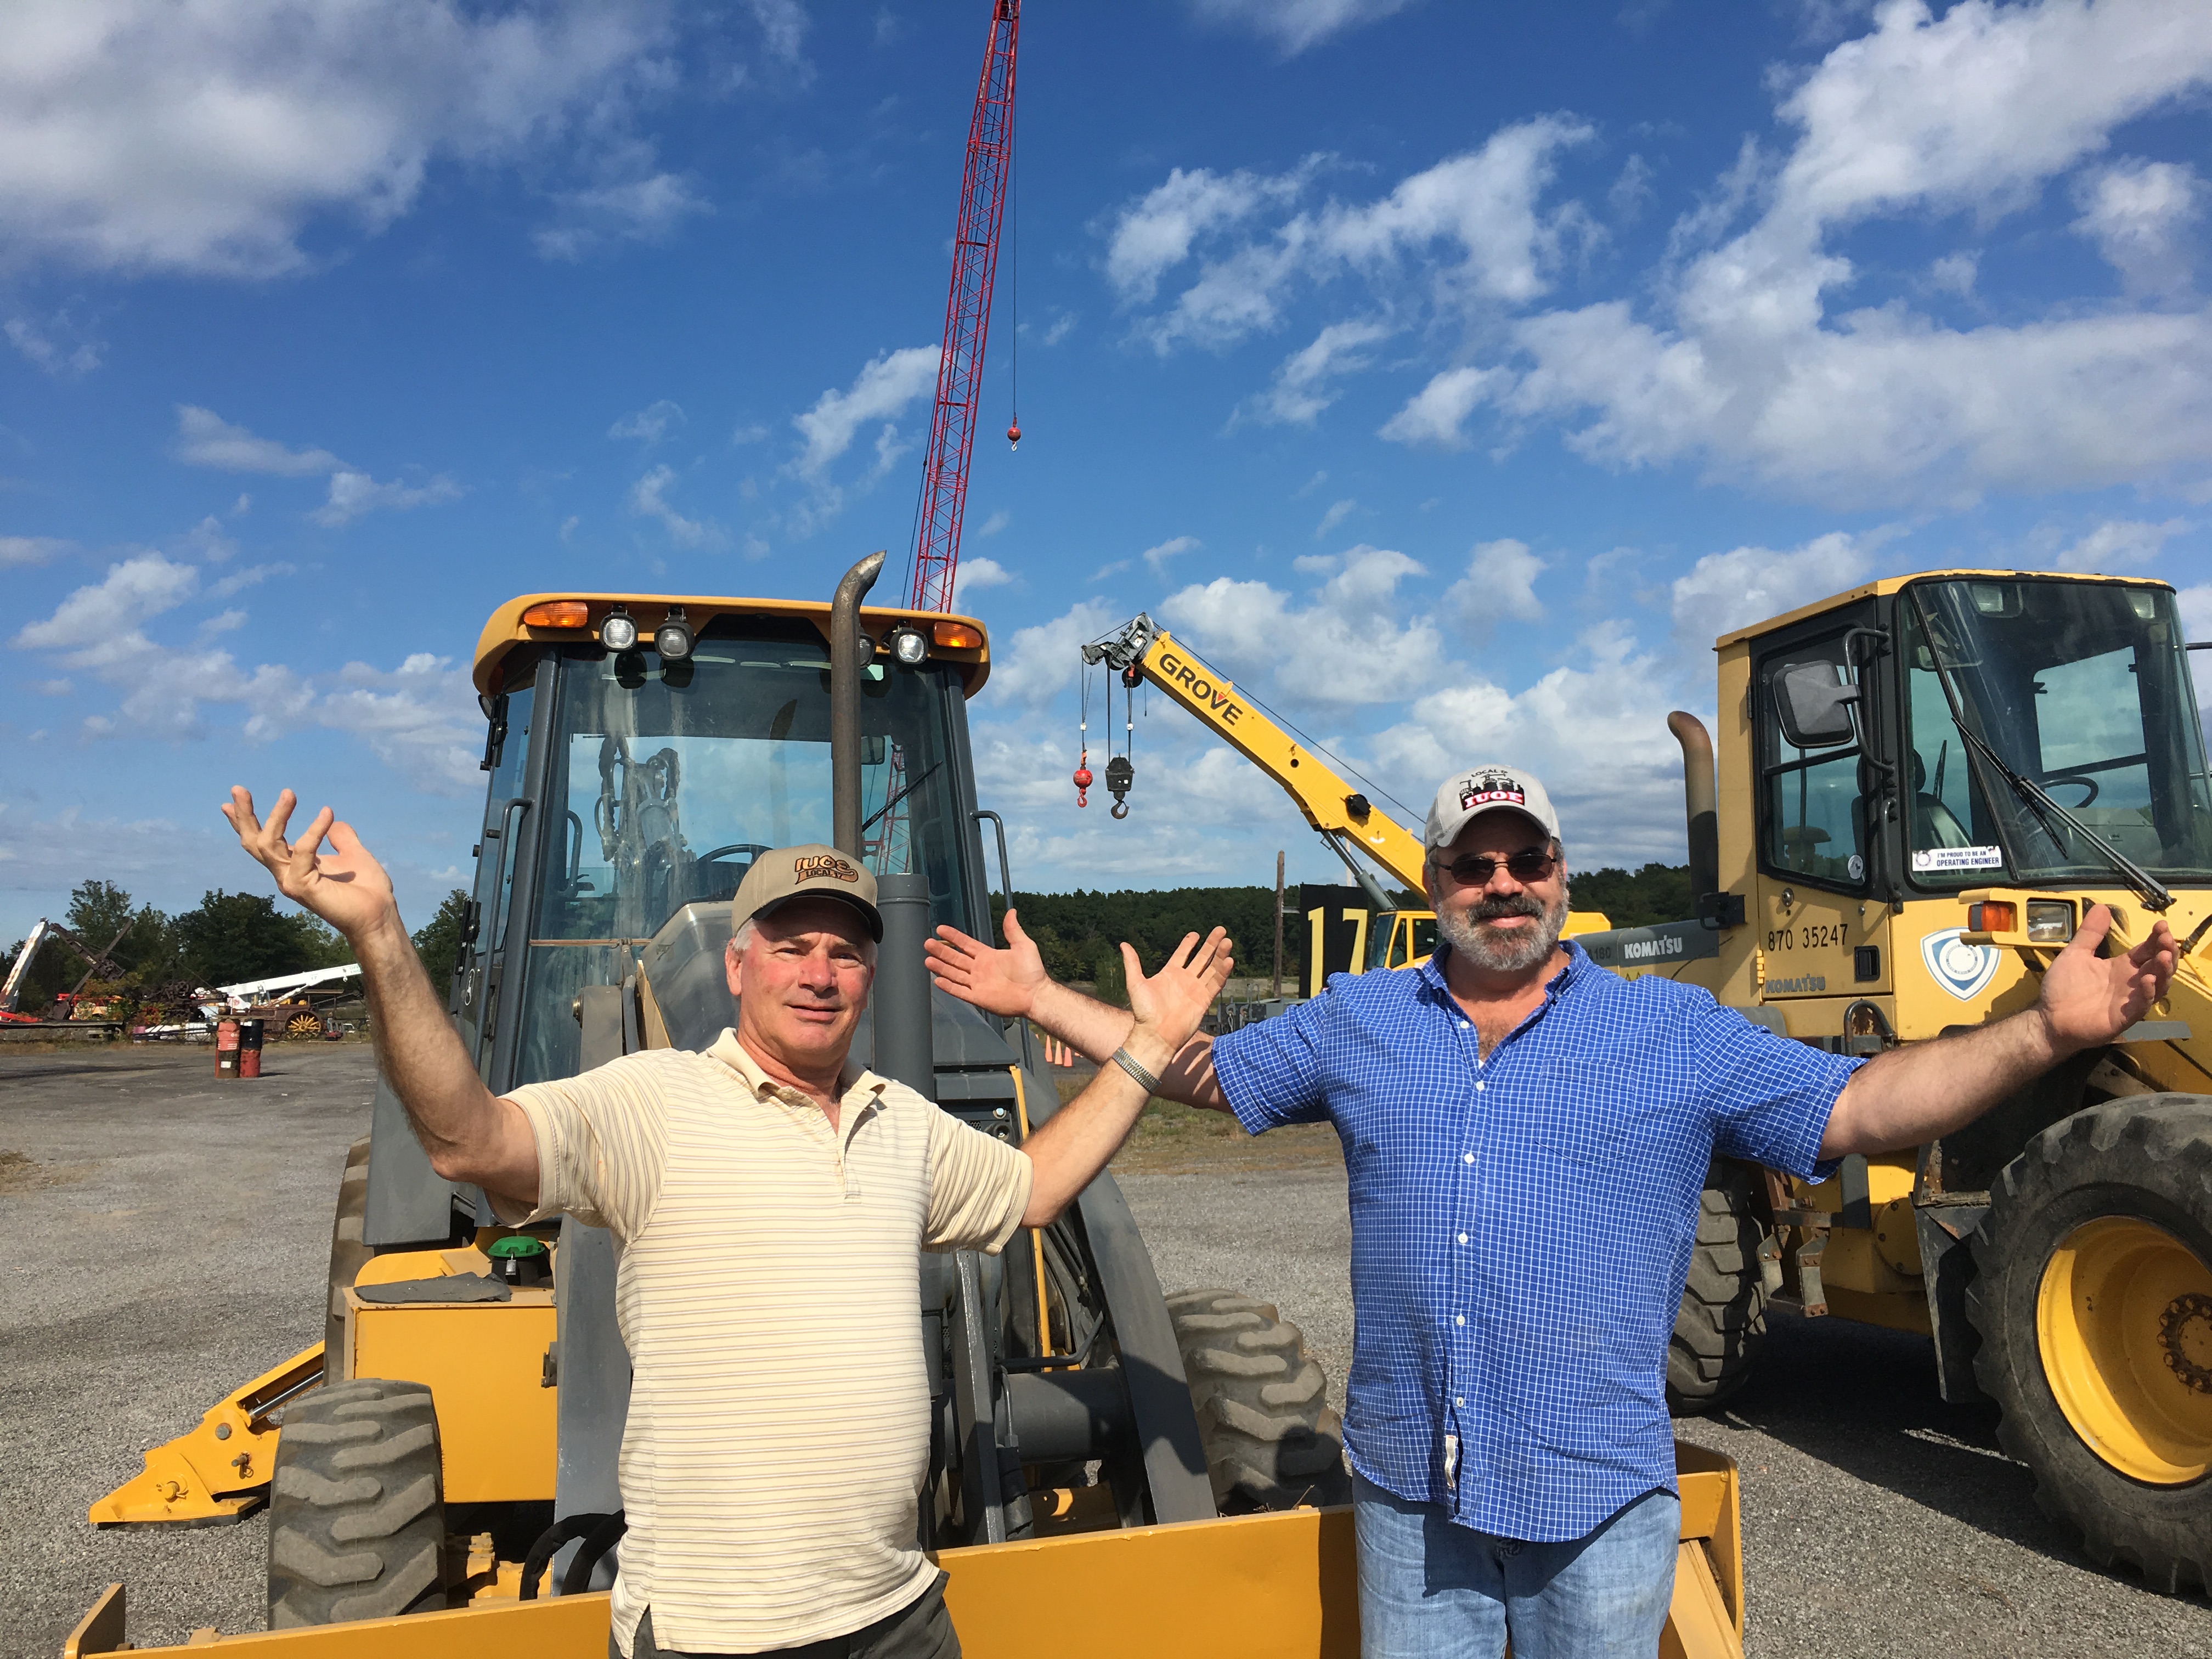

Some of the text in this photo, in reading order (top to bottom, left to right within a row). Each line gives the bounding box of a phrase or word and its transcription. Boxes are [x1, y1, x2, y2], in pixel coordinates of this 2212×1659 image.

[1159, 653, 1243, 726] GROVE
[1471, 769, 1498, 777] LOCAL
[1464, 791, 1523, 808] IUOE
[794, 855, 850, 873] IUOE
[1937, 857, 1999, 867] OPERATING ENGINEER
[806, 869, 833, 877] LOCAL
[1624, 935, 1683, 959] KOMATSU
[1768, 923, 1848, 952] 870 35247
[1308, 906, 1368, 998] 17
[1765, 973, 1826, 994] KOMATSU
